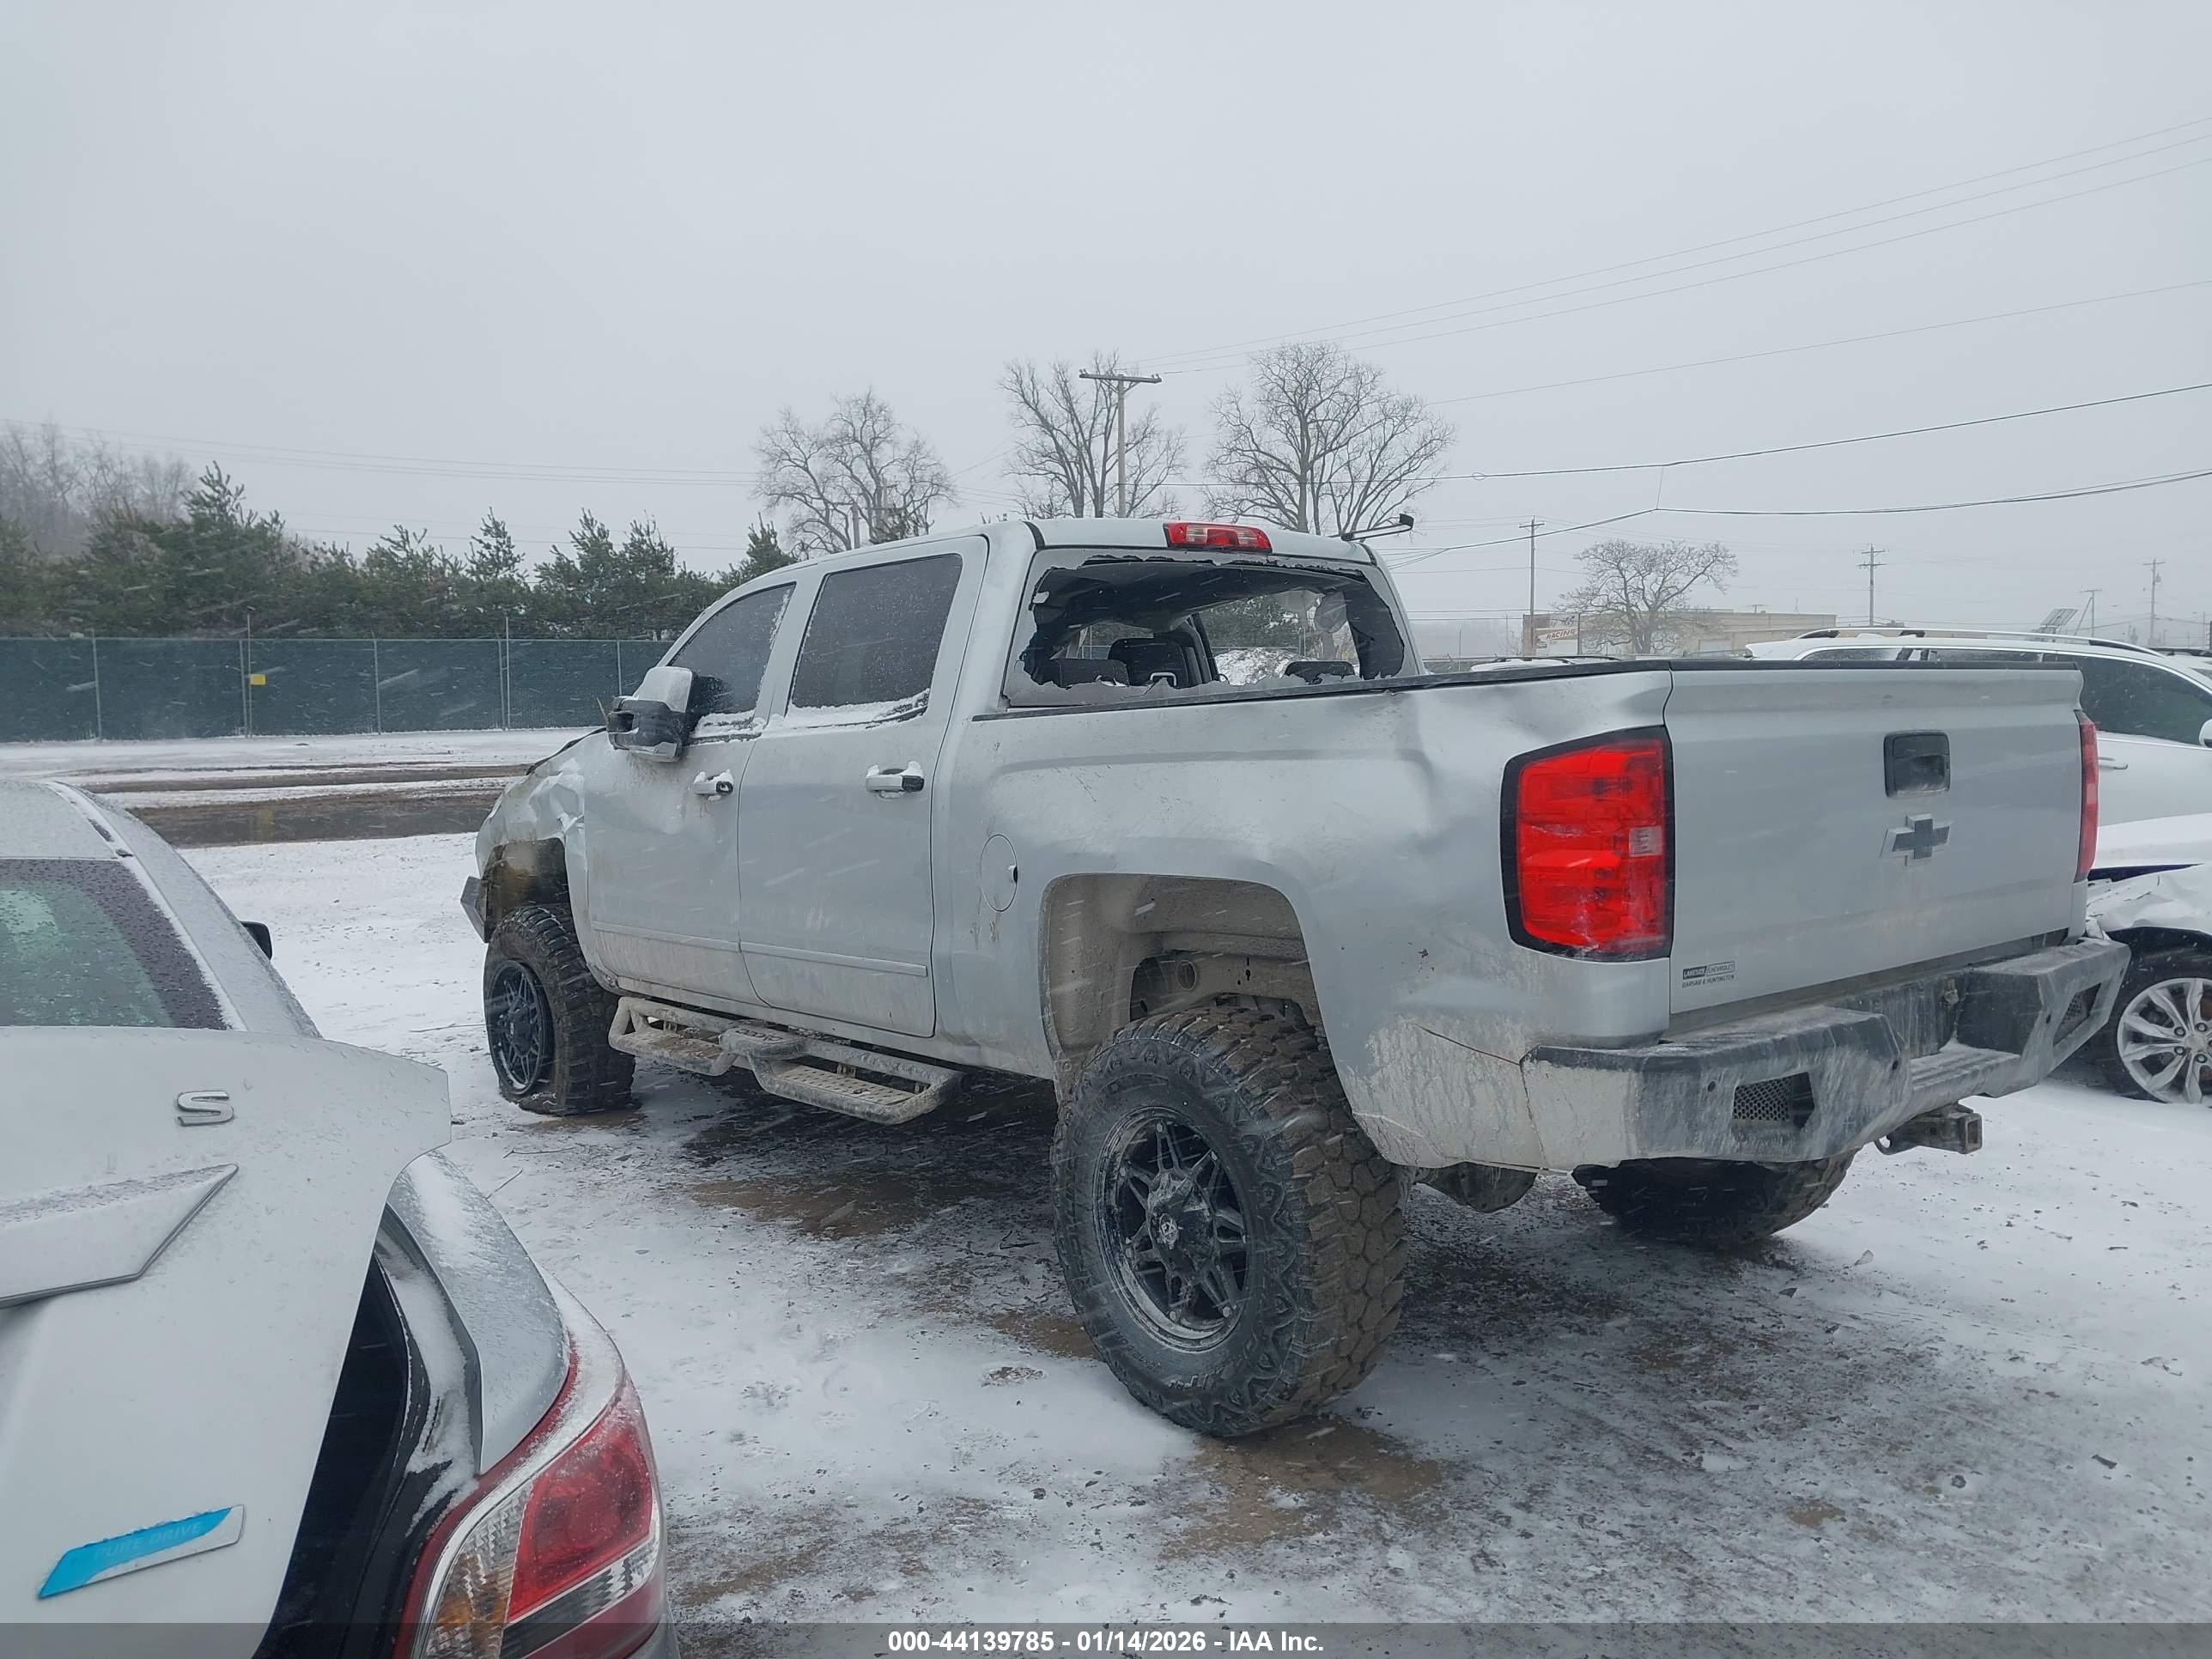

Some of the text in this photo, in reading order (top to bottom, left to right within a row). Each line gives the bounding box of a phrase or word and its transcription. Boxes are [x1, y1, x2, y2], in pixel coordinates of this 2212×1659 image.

[1546, 629, 1576, 640] RACING
[177, 1090, 234, 1127] S
[94, 1521, 204, 1560] PURE DRIVE
